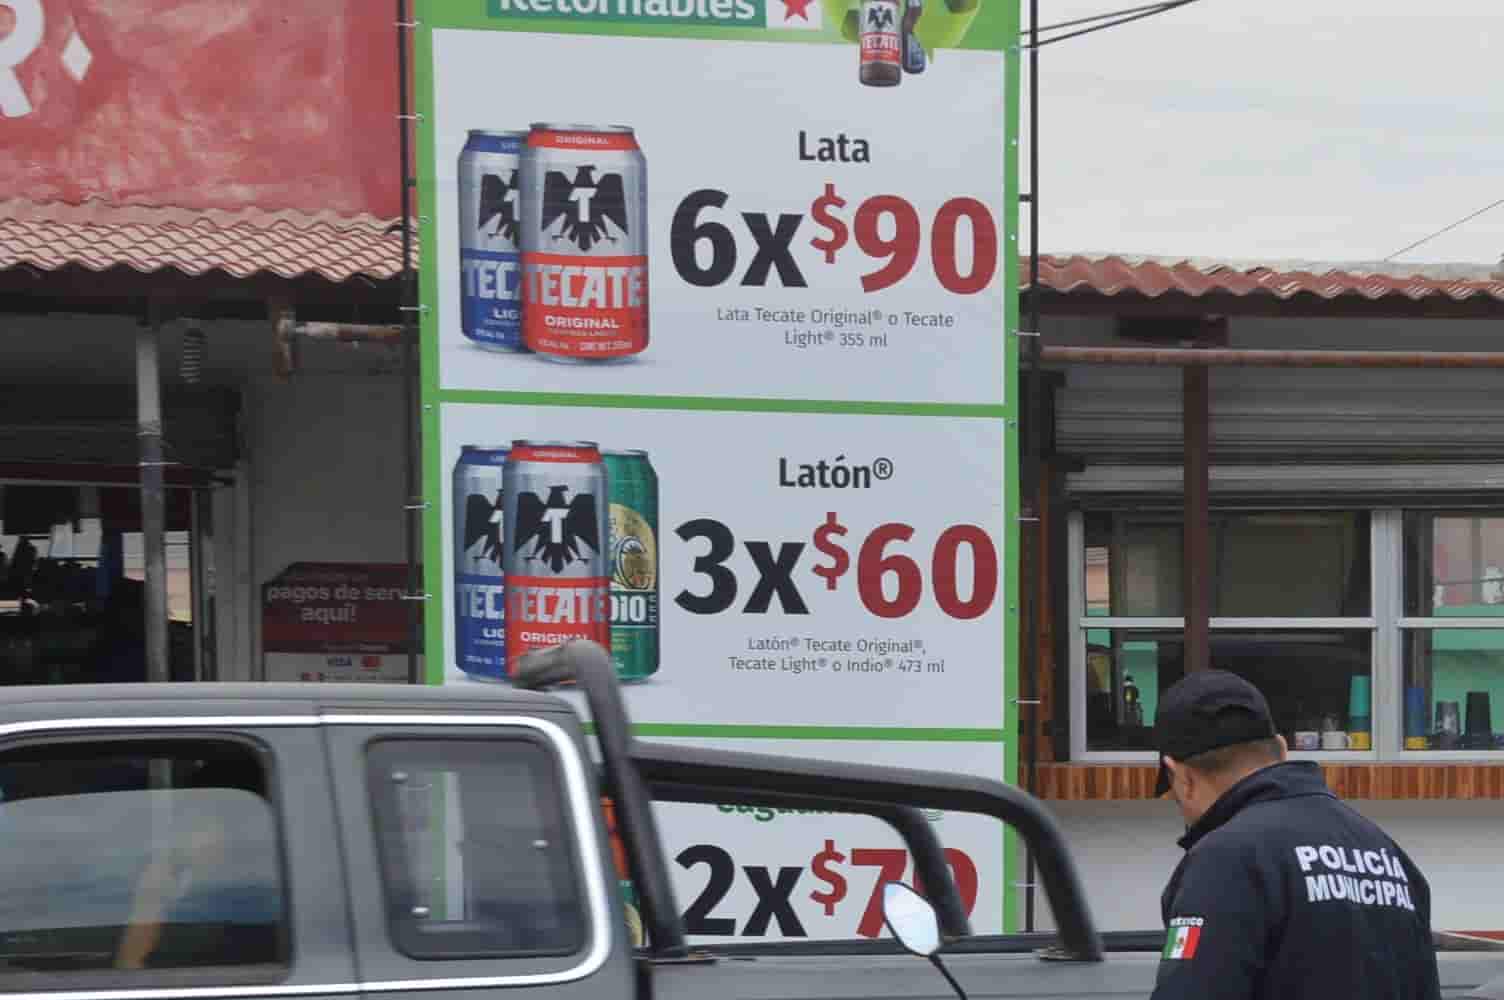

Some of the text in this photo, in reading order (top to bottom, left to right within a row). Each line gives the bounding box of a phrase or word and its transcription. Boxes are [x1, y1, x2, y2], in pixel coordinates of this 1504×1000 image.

[799, 131, 870, 162] Lata
[670, 183, 998, 295] 6x$90
[464, 259, 519, 300] TEC
[525, 263, 642, 308] TECATE
[494, 308, 519, 319] LIG
[545, 315, 620, 329] ORIGINAL
[717, 308, 750, 322] Lata
[755, 308, 806, 324] Tecate
[888, 316, 898, 326] o
[904, 312, 954, 328] Tecate
[840, 333, 865, 348] 355
[869, 334, 888, 348] ml
[673, 511, 998, 620] 3x$60
[267, 584, 410, 603] pagos de serv
[461, 585, 504, 618] TEC
[608, 595, 646, 622] DIO
[804, 638, 850, 652] Tecate
[728, 656, 776, 671] Tecate
[832, 663, 841, 671] o
[898, 660, 921, 672] 473
[928, 660, 945, 672] ml
[1295, 845, 1407, 882] POLICÍA
[1305, 874, 1416, 912] MUNICIPAL
